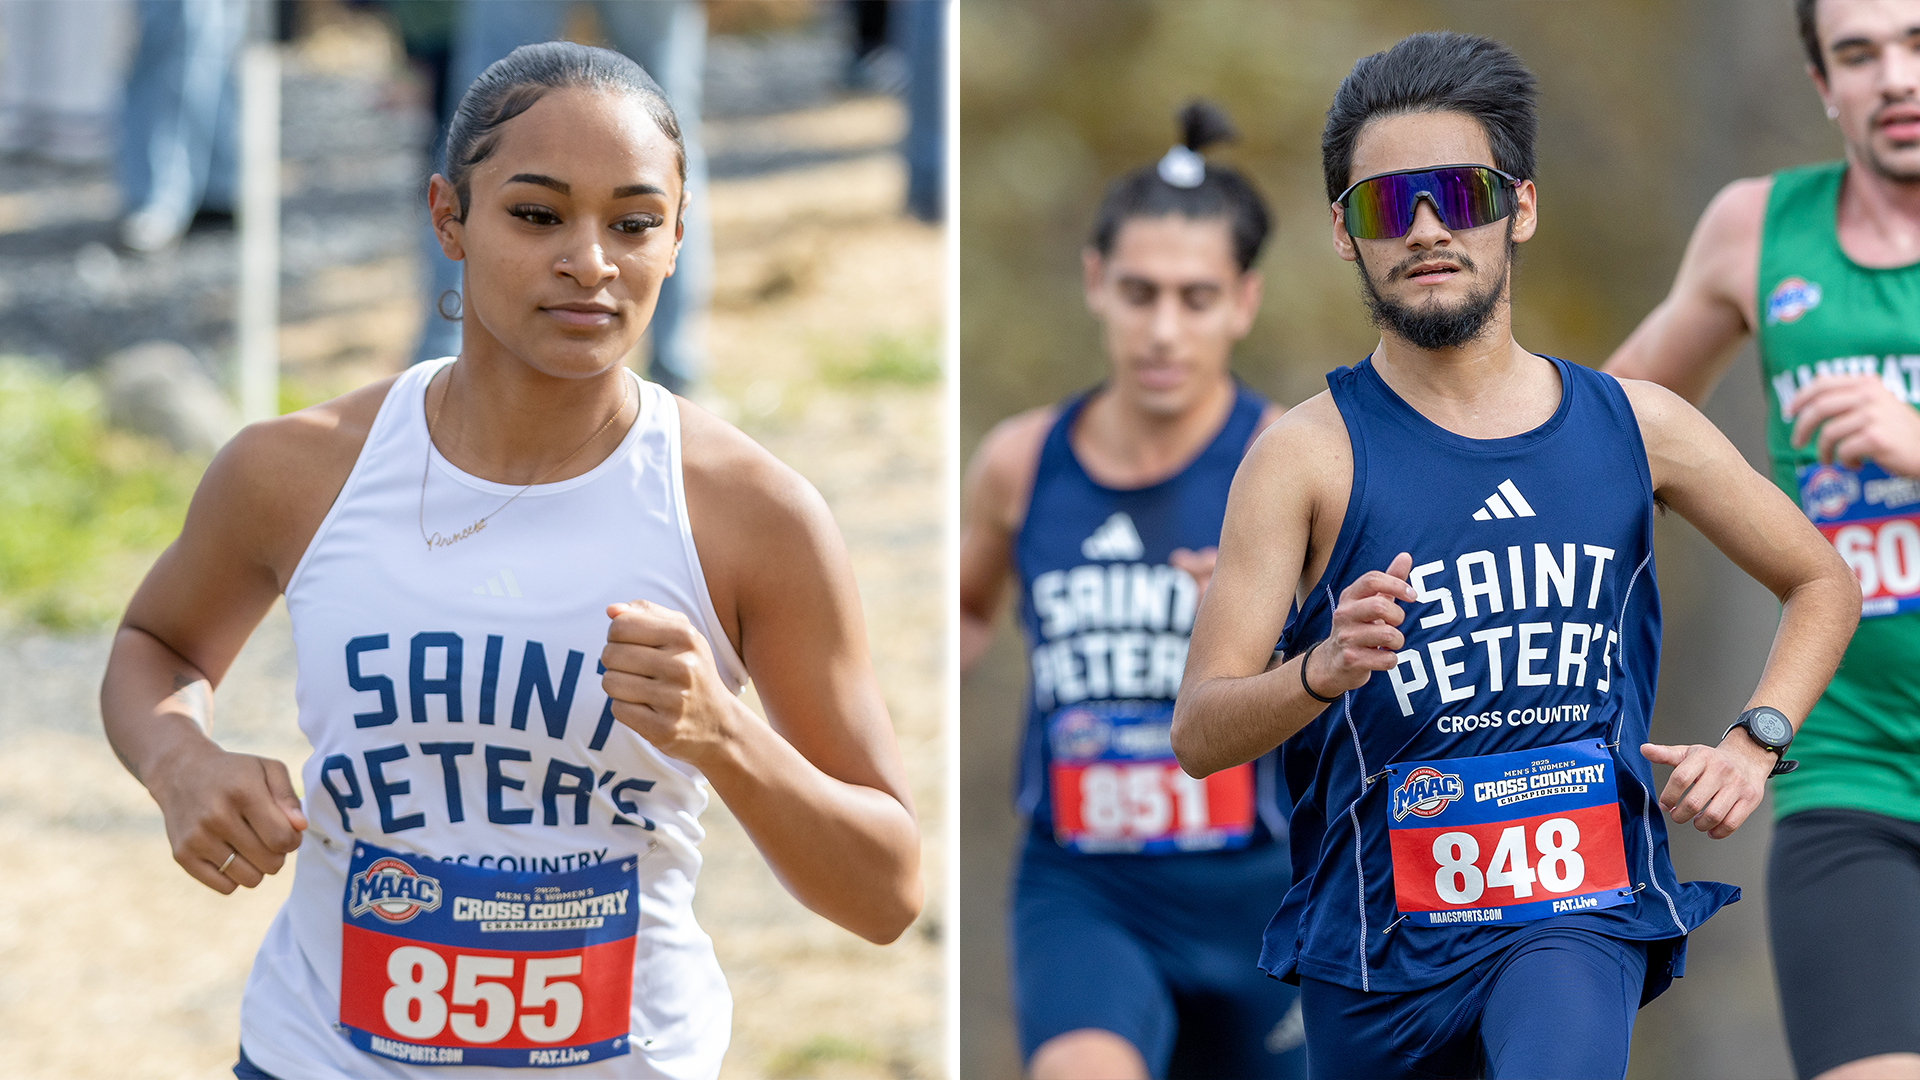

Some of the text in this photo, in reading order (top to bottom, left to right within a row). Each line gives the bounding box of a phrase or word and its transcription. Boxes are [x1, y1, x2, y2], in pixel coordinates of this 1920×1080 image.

[1408, 542, 1616, 630] SAINT
[1387, 621, 1618, 718] PETER'S
[1436, 703, 1591, 734] CROSS COUNTRY
[1503, 759, 1576, 778] MEN'S & WOMEN'S
[1530, 758, 1550, 767] 2025
[321, 741, 657, 834] PETER'S
[1394, 775, 1464, 820] MAAC
[1474, 763, 1605, 803] CROSS COUNTRY
[1500, 785, 1585, 806] CHAMPIONSHIPS
[1079, 763, 1210, 839] 851
[1431, 817, 1586, 905] 848
[351, 871, 442, 915] MAAC
[453, 896, 526, 922] CROSS
[528, 888, 630, 920] COUNTRY
[1552, 896, 1598, 913] FAT.Live
[484, 918, 600, 931] CHAMPIONSHIPS
[1429, 908, 1503, 925] MAACSPORTS.COM
[383, 945, 584, 1044] 855
[371, 1035, 464, 1063] MAACSPORTS.COM
[528, 1049, 591, 1065] FAT.Live
